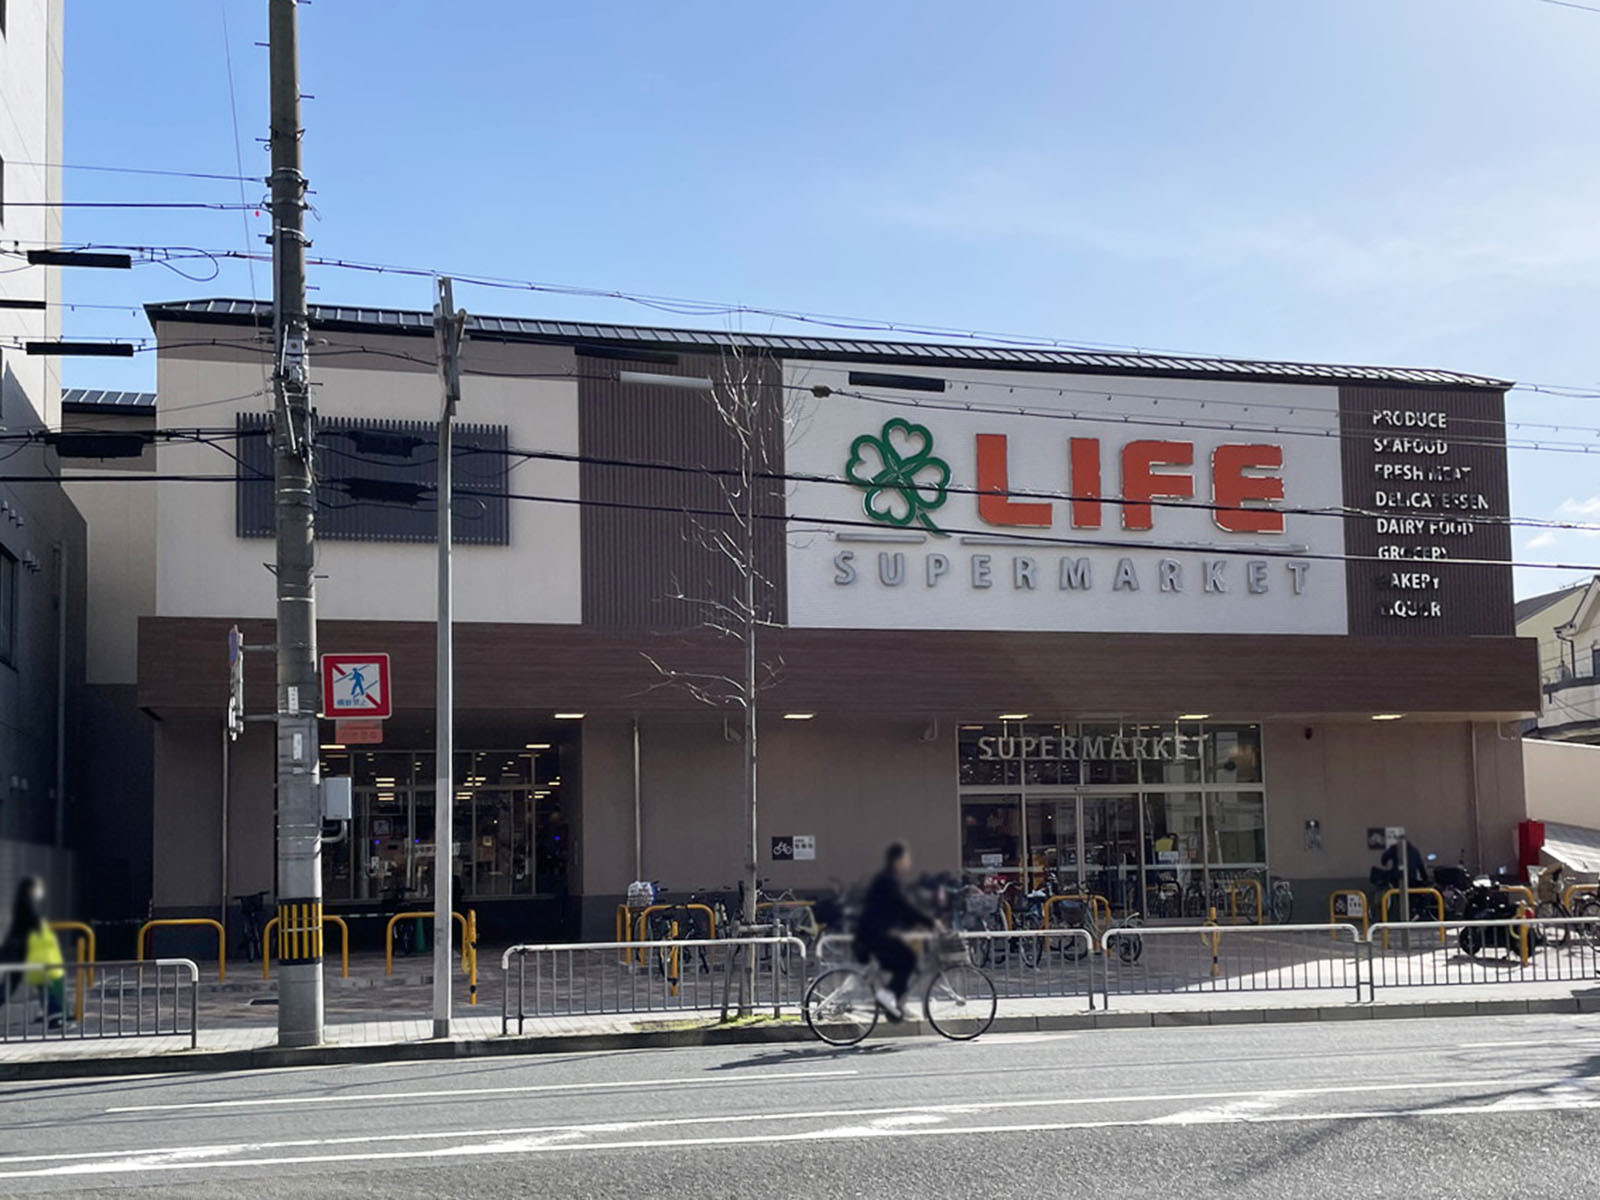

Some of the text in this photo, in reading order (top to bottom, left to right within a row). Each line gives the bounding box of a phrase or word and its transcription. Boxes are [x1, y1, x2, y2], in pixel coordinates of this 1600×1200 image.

[1372, 409, 1447, 428] PRODUCE
[975, 433, 1287, 534] LIFE
[1376, 517, 1424, 535] DAIRY
[833, 549, 1311, 596] SUPERMARKET
[1389, 572, 1440, 589] AKERY
[978, 734, 1209, 761] SUPERMARKET
